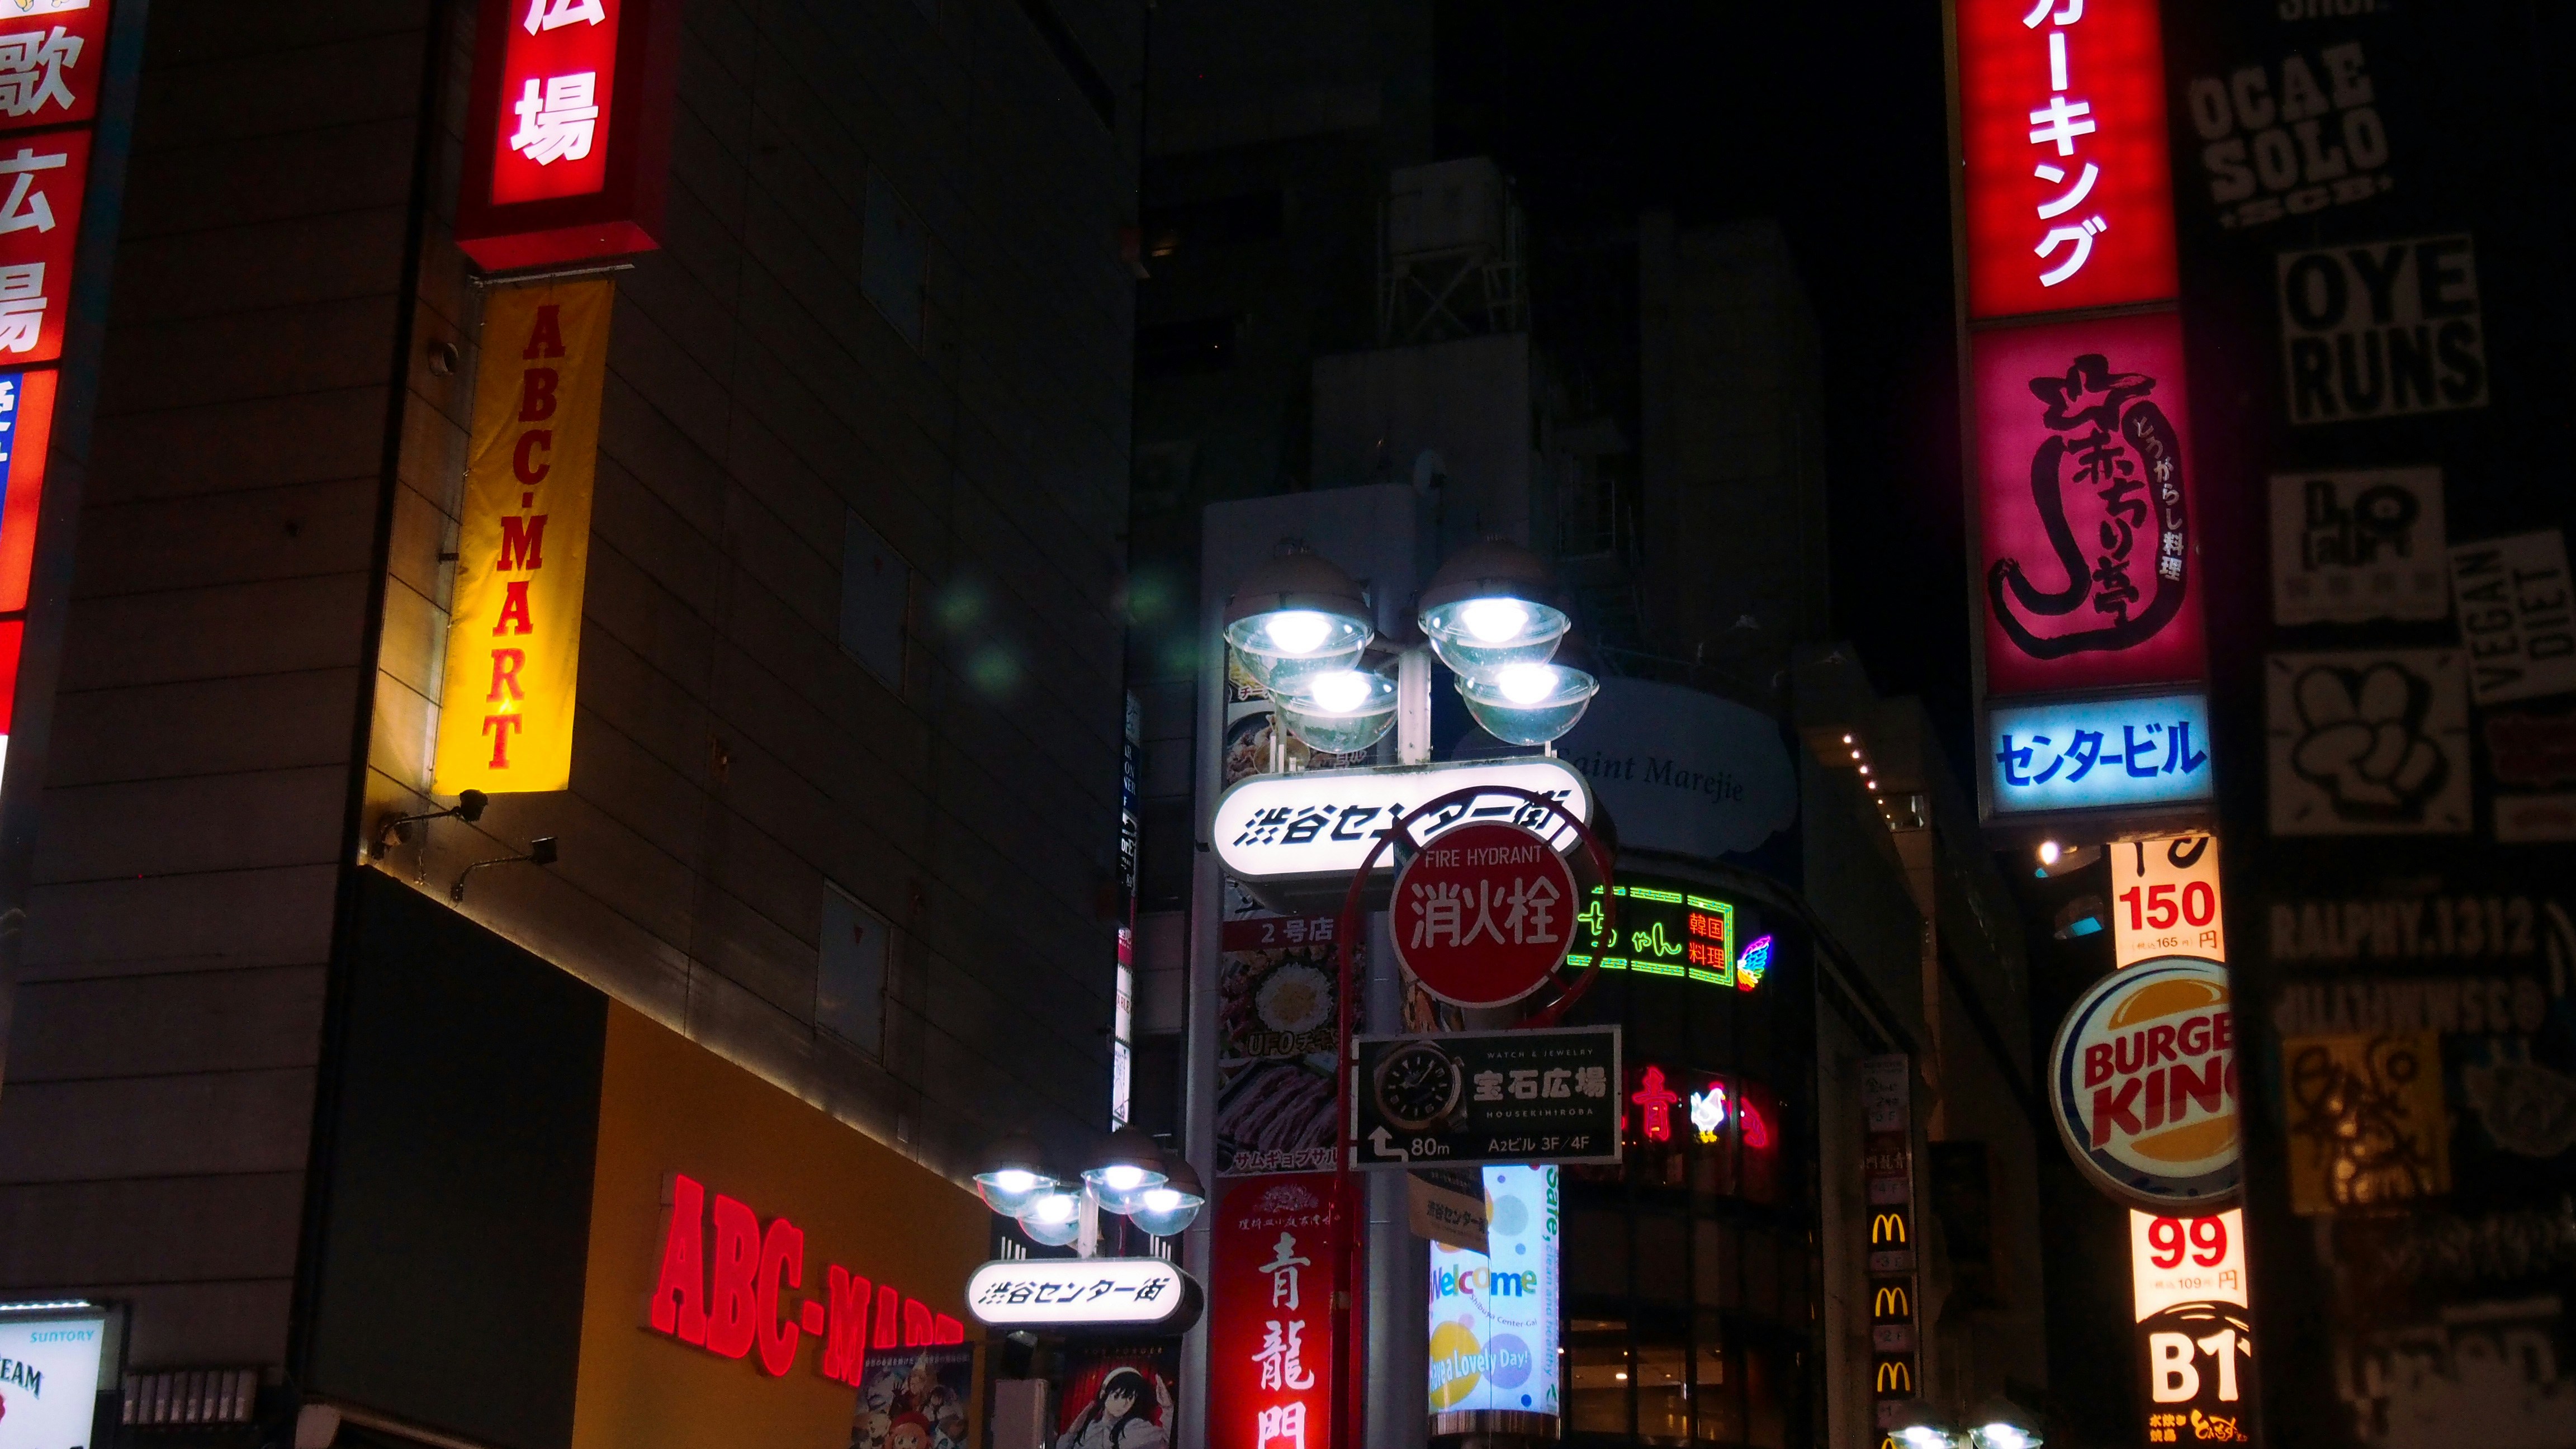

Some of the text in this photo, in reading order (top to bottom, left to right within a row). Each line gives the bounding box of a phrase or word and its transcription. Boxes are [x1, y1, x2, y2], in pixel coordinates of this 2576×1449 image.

[2203, 106, 2390, 204] SOLO
[2285, 239, 2473, 331] OYE
[2293, 321, 2484, 419] RUNS
[2133, 416, 2184, 583] とうがらし料理
[481, 304, 566, 770] ABC-MART
[2454, 548, 2522, 692] VEGAN
[2515, 568, 2574, 661] DIET
[1996, 721, 2208, 787] センタービル
[1233, 789, 1572, 847] 渋谷セター街
[1425, 844, 1543, 869] FIRE HYDRANT
[1410, 874, 1561, 950] 消火栓
[1689, 912, 1724, 941] 韓国
[2119, 880, 2215, 931] 150
[1261, 916, 1334, 944] 2号店
[2199, 930, 2218, 950] 円
[1689, 942, 1725, 970] 料理
[1486, 1051, 1525, 1060] WATCH
[1543, 1048, 1594, 1058] JEWELRY
[1473, 1066, 1607, 1102] 宝石広場
[1486, 1107, 1594, 1119] HOUSEKIHIROBA
[1410, 1138, 1450, 1157] 80m
[1488, 1137, 1536, 1153] A2ビル
[2148, 1214, 2228, 1270] 99
[978, 1276, 1173, 1305] 渋谷センター街
[1430, 1263, 1538, 1305] Welcome
[1469, 1294, 1496, 1320] Shibuya
[1251, 1232, 1315, 1449] 青龍門
[0, 1356, 45, 1400] EAM
[1446, 1357, 1453, 1382] a
[1454, 1348, 1498, 1379] Lovely
[1500, 1348, 1528, 1369] Day!
[2149, 1329, 2239, 1403] B1
